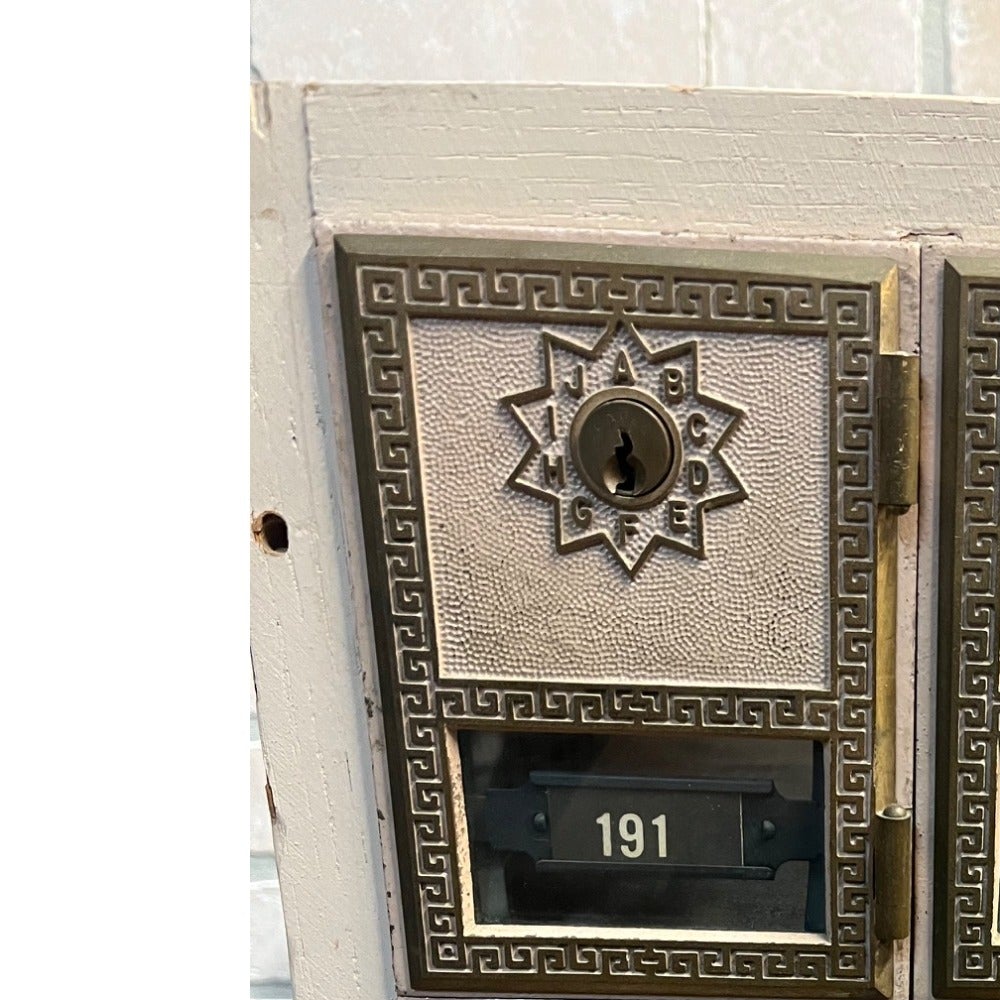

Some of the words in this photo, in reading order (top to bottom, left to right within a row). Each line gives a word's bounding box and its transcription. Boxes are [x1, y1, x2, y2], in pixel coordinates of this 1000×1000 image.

[563, 363, 584, 398] J
[611, 349, 636, 386] A
[662, 367, 687, 404] B
[686, 412, 708, 445] C
[542, 454, 567, 488] H
[687, 459, 710, 495] D
[570, 495, 593, 529] G
[668, 500, 690, 533] E
[617, 513, 642, 546] F
[597, 813, 667, 858] 191
